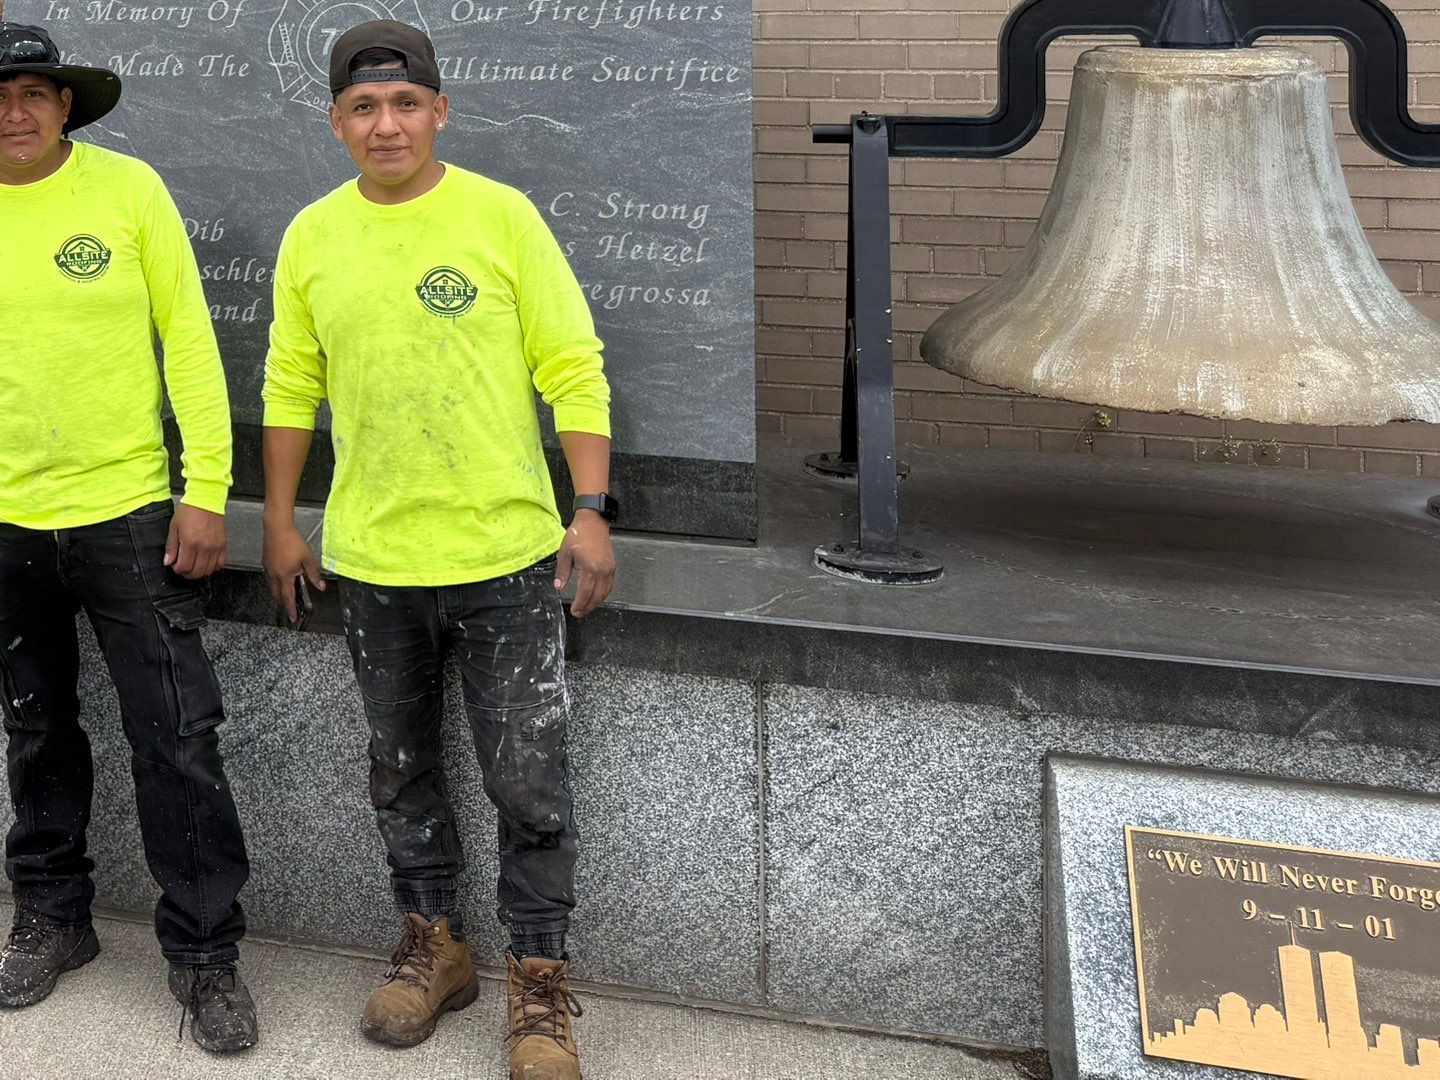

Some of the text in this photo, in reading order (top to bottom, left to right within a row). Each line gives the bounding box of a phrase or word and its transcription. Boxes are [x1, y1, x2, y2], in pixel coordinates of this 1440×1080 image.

[42, 0, 71, 21] In
[450, 0, 509, 23] Our
[108, 52, 185, 78] Made
[197, 54, 251, 78] The
[437, 56, 576, 83] Ultimate
[592, 57, 741, 91] Sacrifice
[549, 191, 711, 230] C. Strong
[58, 250, 109, 264] ALLSITE
[594, 231, 711, 264] Hetzel
[420, 285, 475, 296] ALLSITE
[1212, 855, 1269, 885] Will
[1279, 864, 1358, 896] Never
[1368, 875, 1440, 911] Forg
[1242, 899, 1258, 921] 9
[1297, 906, 1325, 931] 11
[1364, 914, 1396, 941] 01
